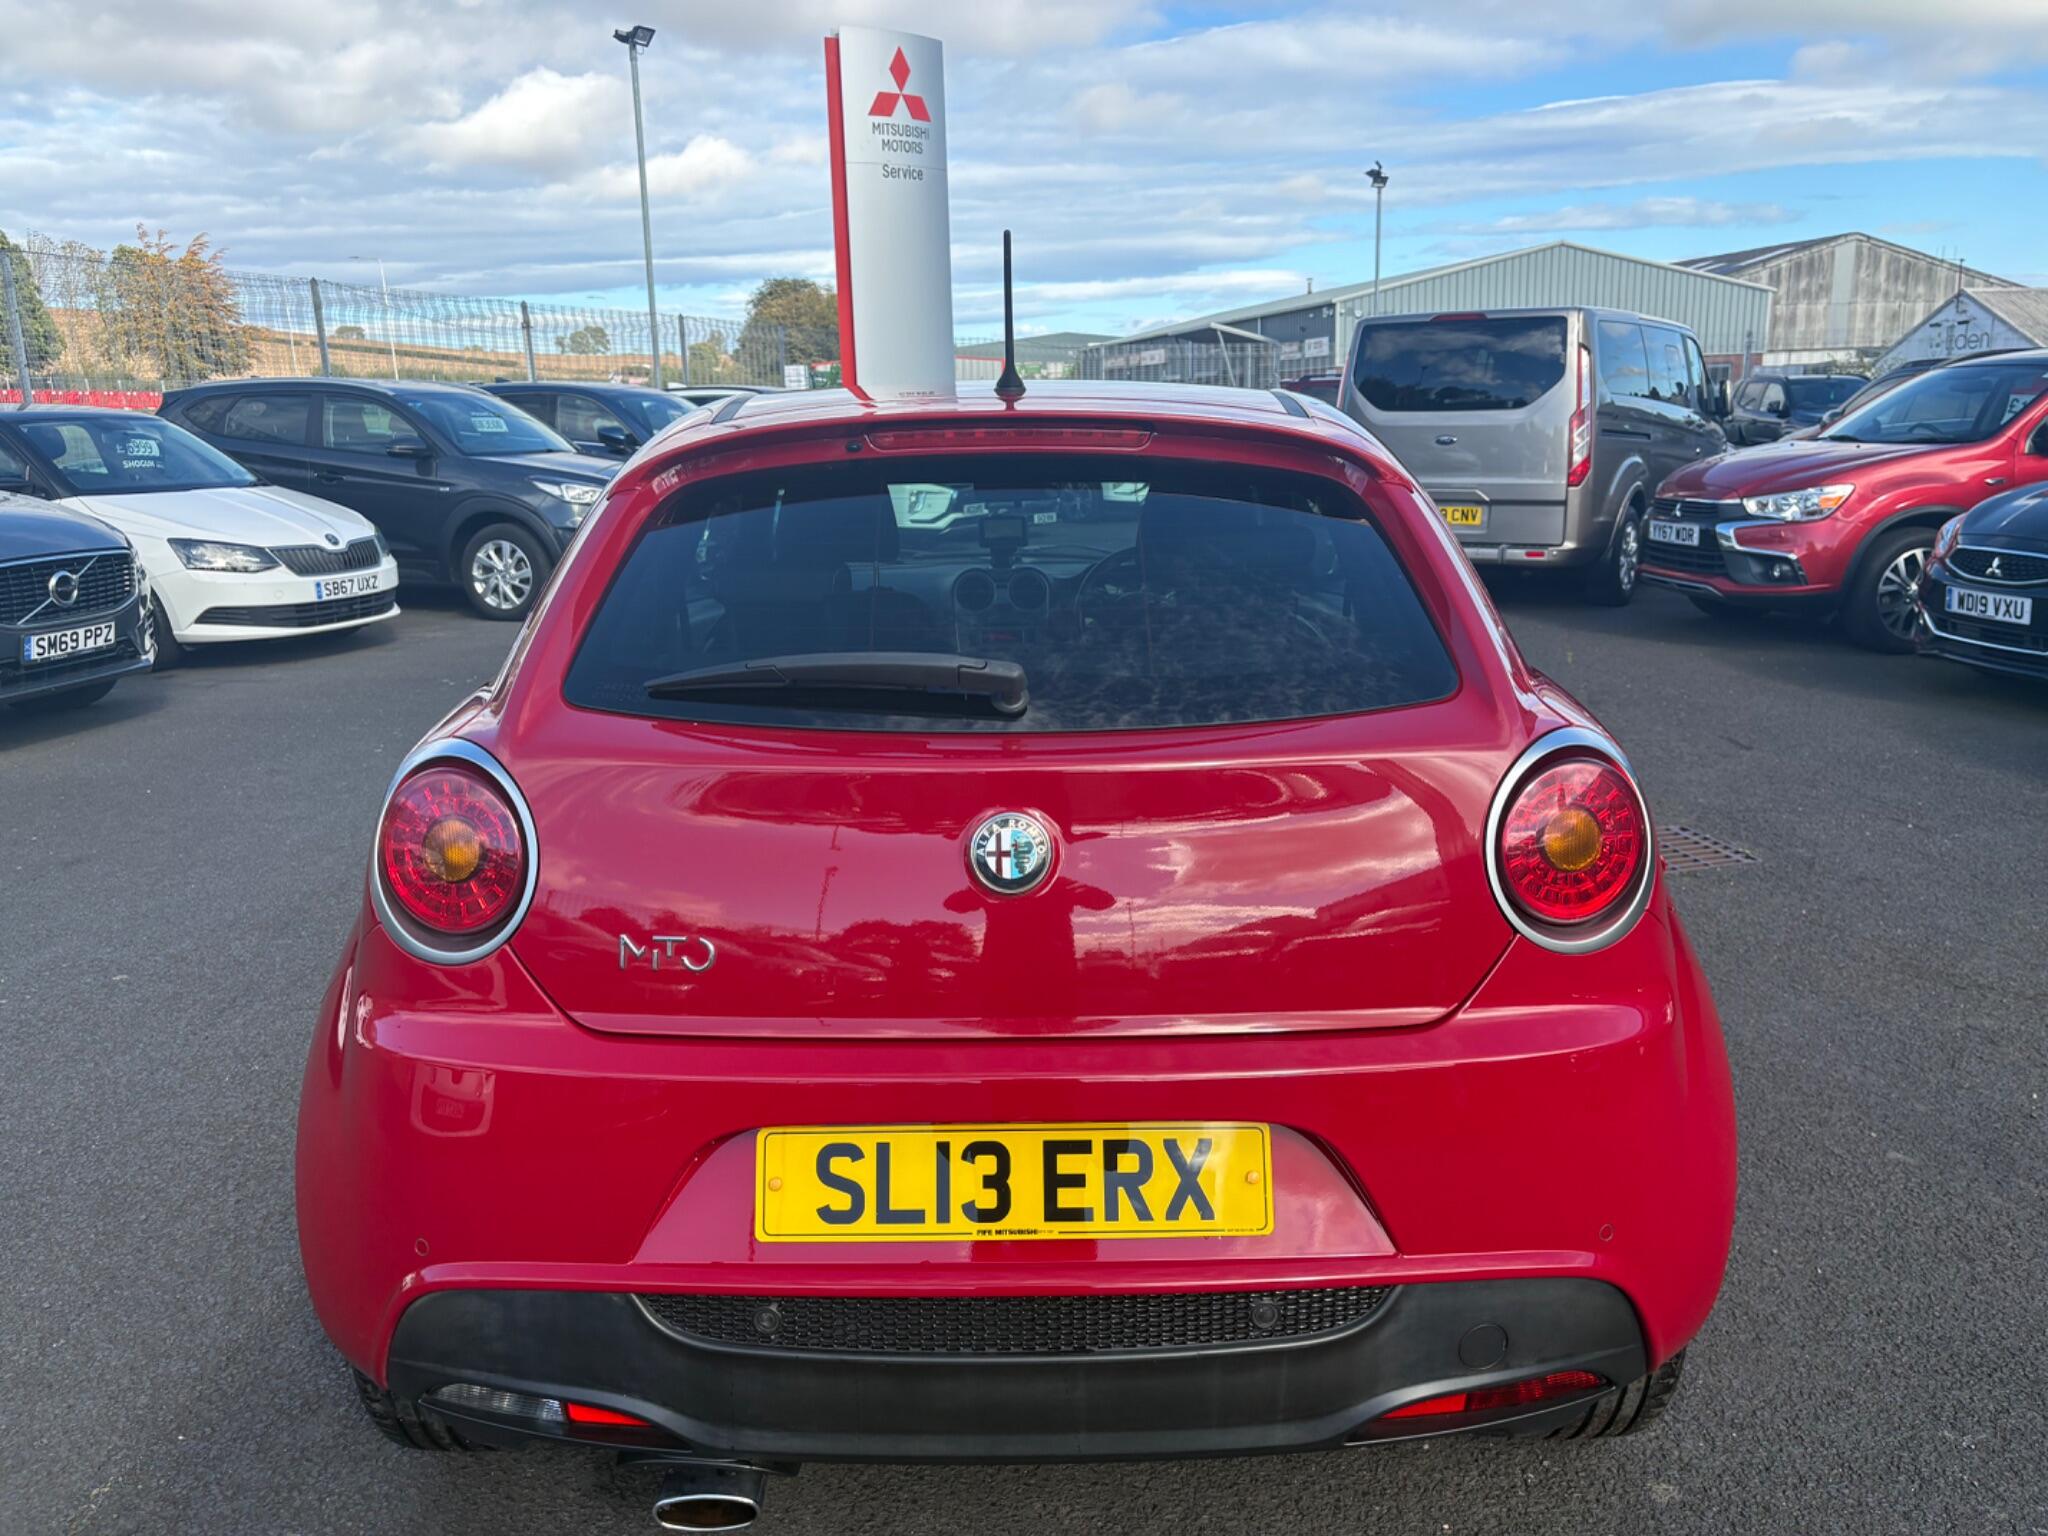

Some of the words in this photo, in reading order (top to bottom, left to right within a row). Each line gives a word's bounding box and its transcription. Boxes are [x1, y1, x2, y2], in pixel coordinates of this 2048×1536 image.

[872, 122, 930, 140] MITSUBISHI
[881, 139, 923, 154] MOTORS
[882, 163, 923, 181] Service
[1452, 508, 1478, 522] CNV
[323, 578, 355, 597] SB67
[356, 575, 378, 592] UXZ
[1957, 590, 1989, 614] WD19
[1993, 596, 2025, 620] VXU
[36, 630, 80, 656] SM69
[84, 623, 113, 648] PPZ
[1009, 818, 1047, 854] ROMEO
[815, 1140, 1012, 1224] SL13
[1042, 1137, 1216, 1223] ERX
[994, 1228, 1038, 1236] MITSUBISHI
